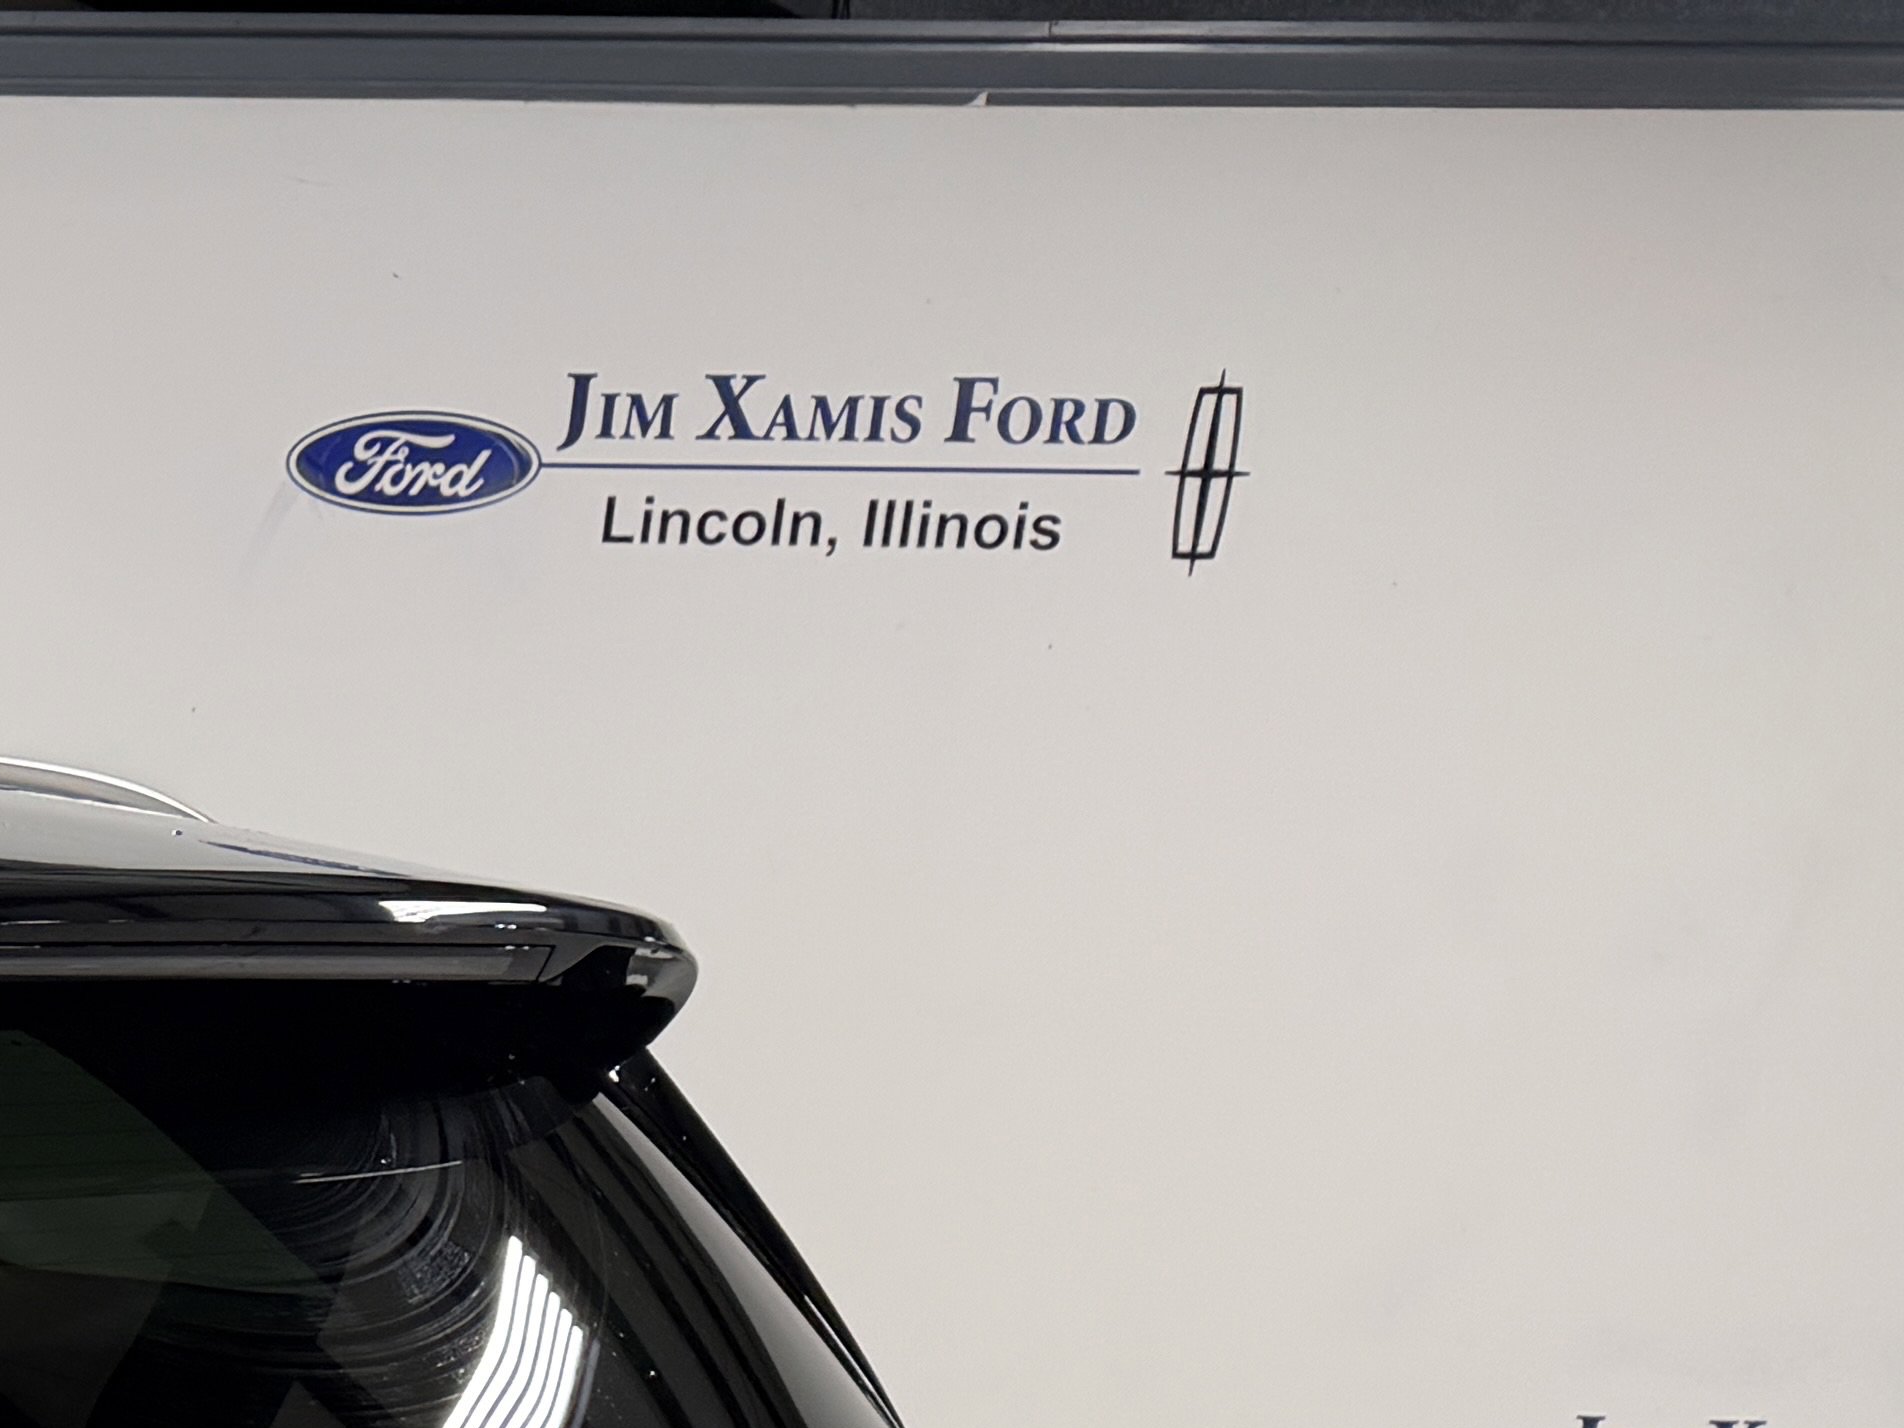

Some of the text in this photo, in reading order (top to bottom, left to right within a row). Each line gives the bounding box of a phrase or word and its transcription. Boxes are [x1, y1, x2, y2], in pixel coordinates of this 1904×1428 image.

[556, 373, 1136, 452] JIM XAMIS FORD
[333, 427, 489, 501] Ford
[601, 495, 1062, 556] Lincoln, Illinois
